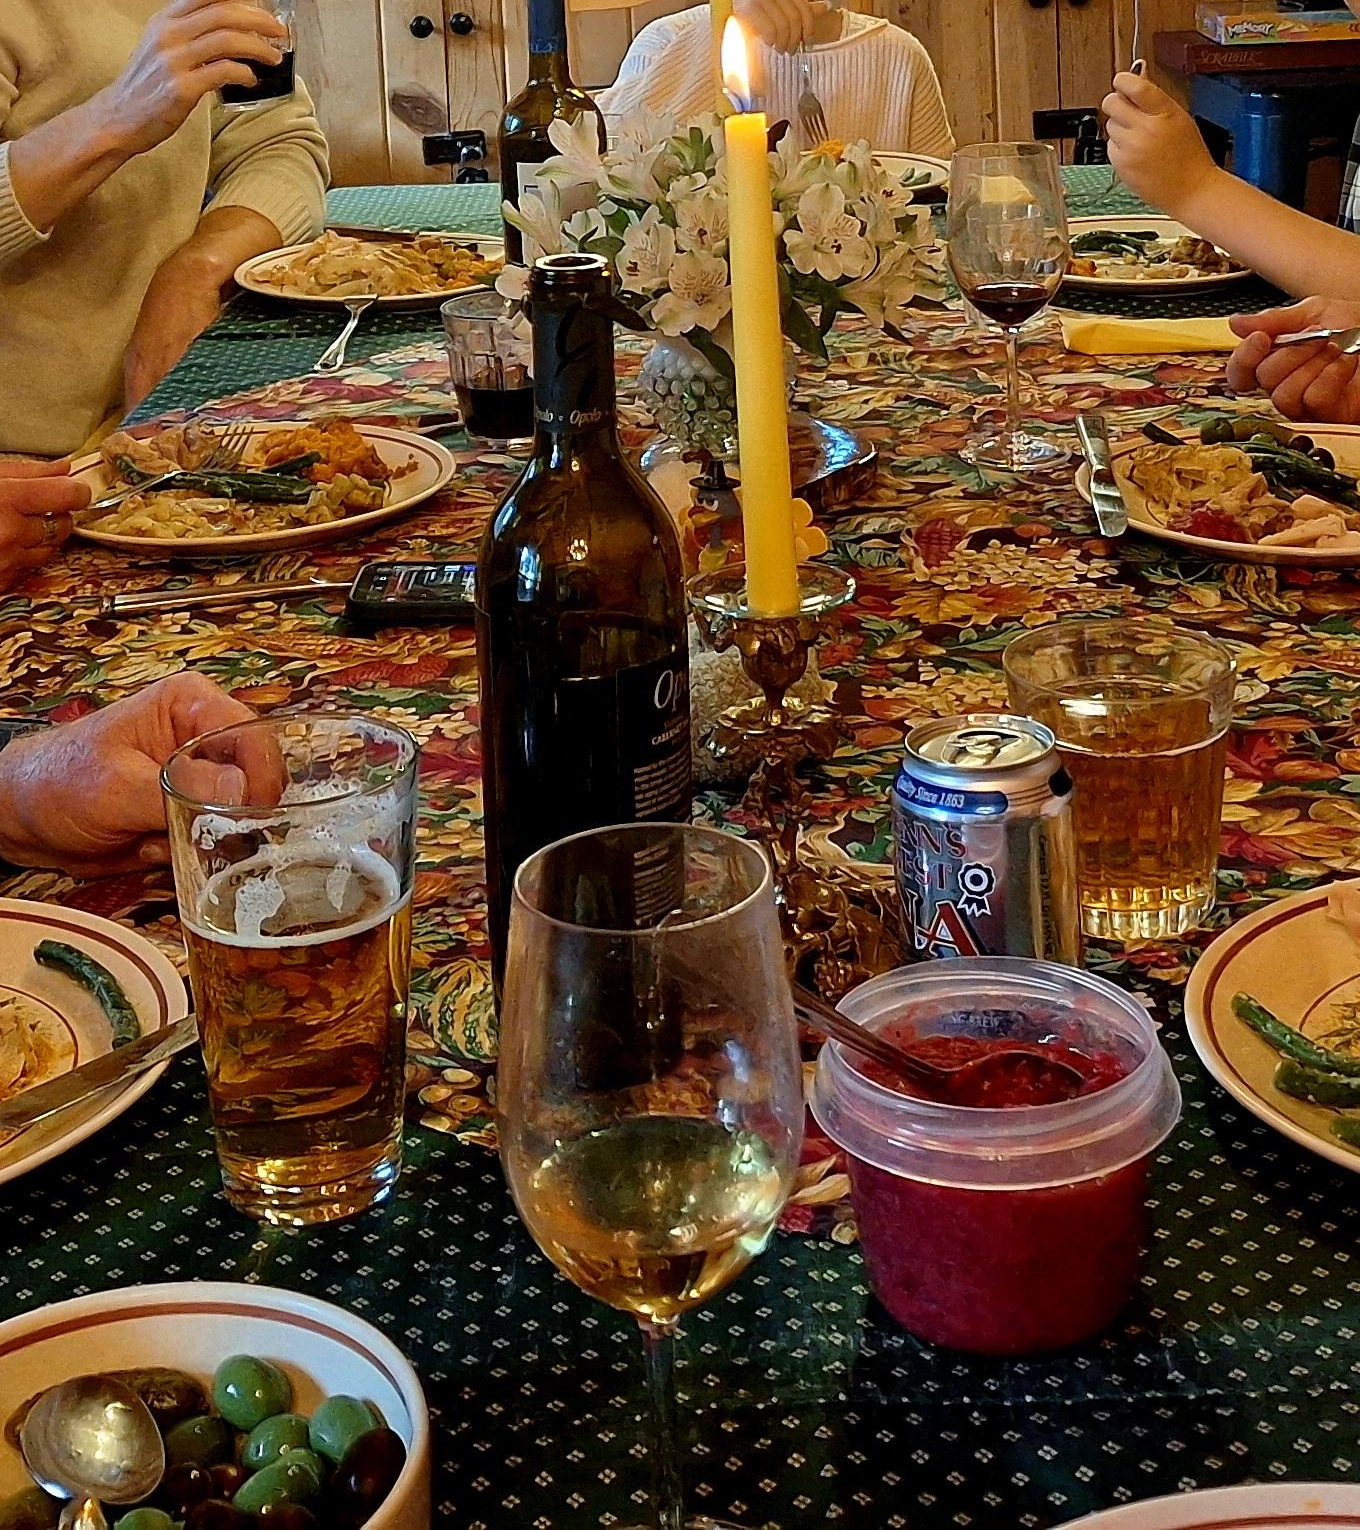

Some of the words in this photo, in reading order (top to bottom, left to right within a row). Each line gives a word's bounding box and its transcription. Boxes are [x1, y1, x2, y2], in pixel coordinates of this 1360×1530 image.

[1227, 21, 1274, 38] MEMORY
[654, 670, 688, 713] Op
[939, 792, 966, 809] 1863
[897, 844, 953, 890] EST
